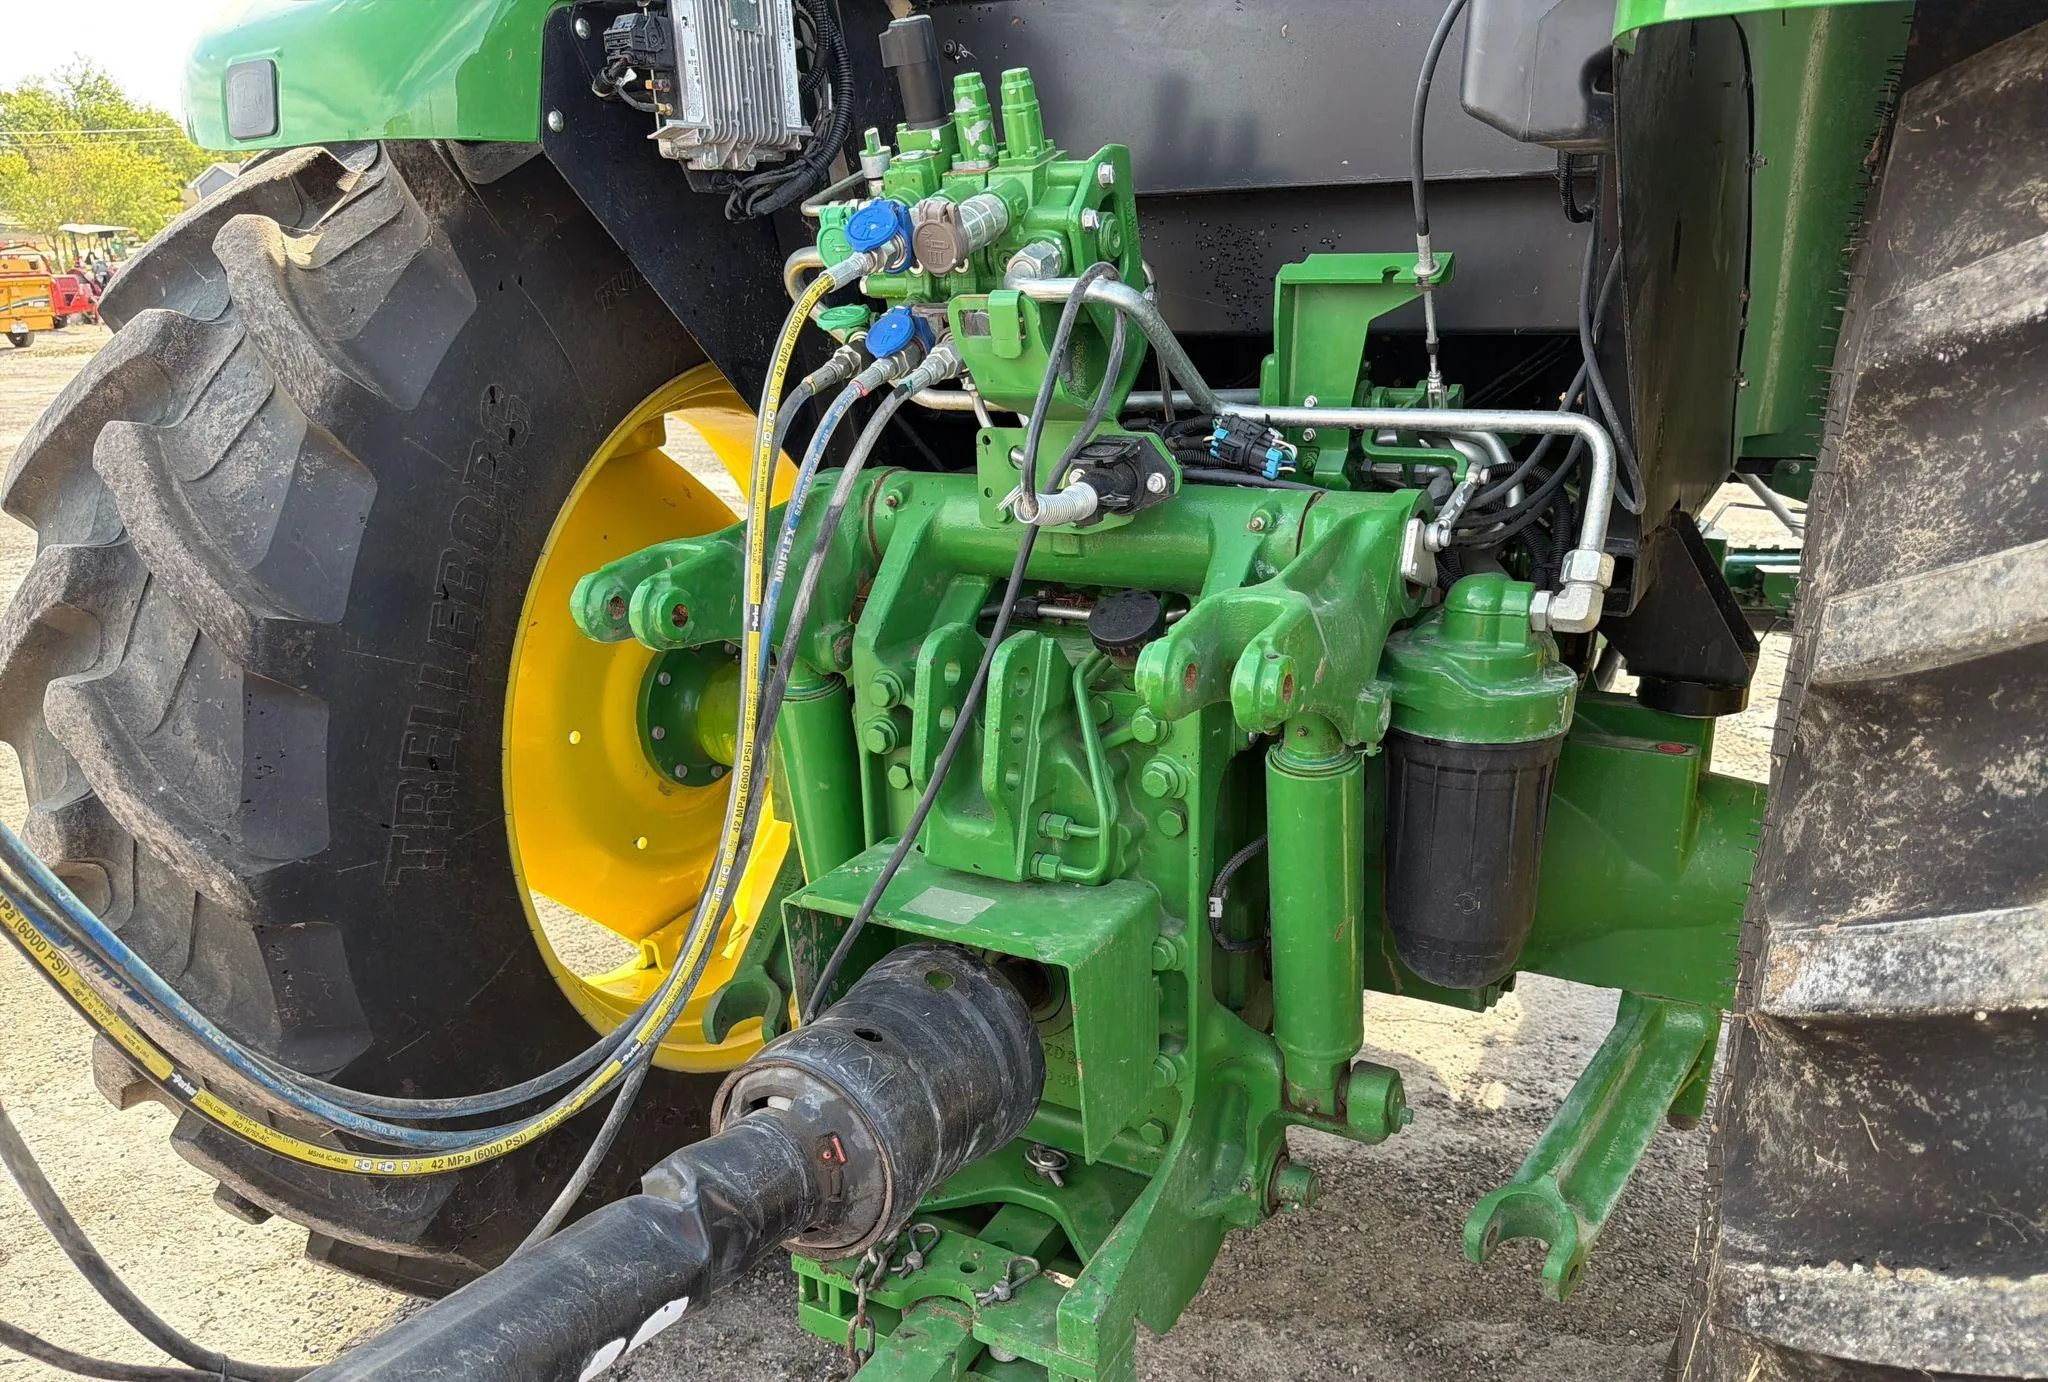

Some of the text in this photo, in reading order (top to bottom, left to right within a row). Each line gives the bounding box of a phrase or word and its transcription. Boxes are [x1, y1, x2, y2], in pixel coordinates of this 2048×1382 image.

[796, 297, 813, 317] PSI)
[785, 315, 803, 342] (6000
[778, 342, 792, 365] MPa
[774, 365, 785, 379] 42
[751, 604, 760, 628] Parker
[743, 741, 753, 762] PSI)
[739, 765, 751, 793] (6000
[735, 795, 746, 818] MPa
[732, 820, 741, 833] 42
[13, 917, 49, 955] (6000
[42, 949, 72, 979] PSI)
[621, 1040, 643, 1062] Parker
[171, 1073, 200, 1098] Parker
[231, 1119, 243, 1130] ISO
[307, 1149, 325, 1159] MSHA
[430, 1158, 445, 1170] 42
[446, 1153, 472, 1167] MPa
[473, 1143, 504, 1161] (6000
[504, 1132, 529, 1150] PSI)
